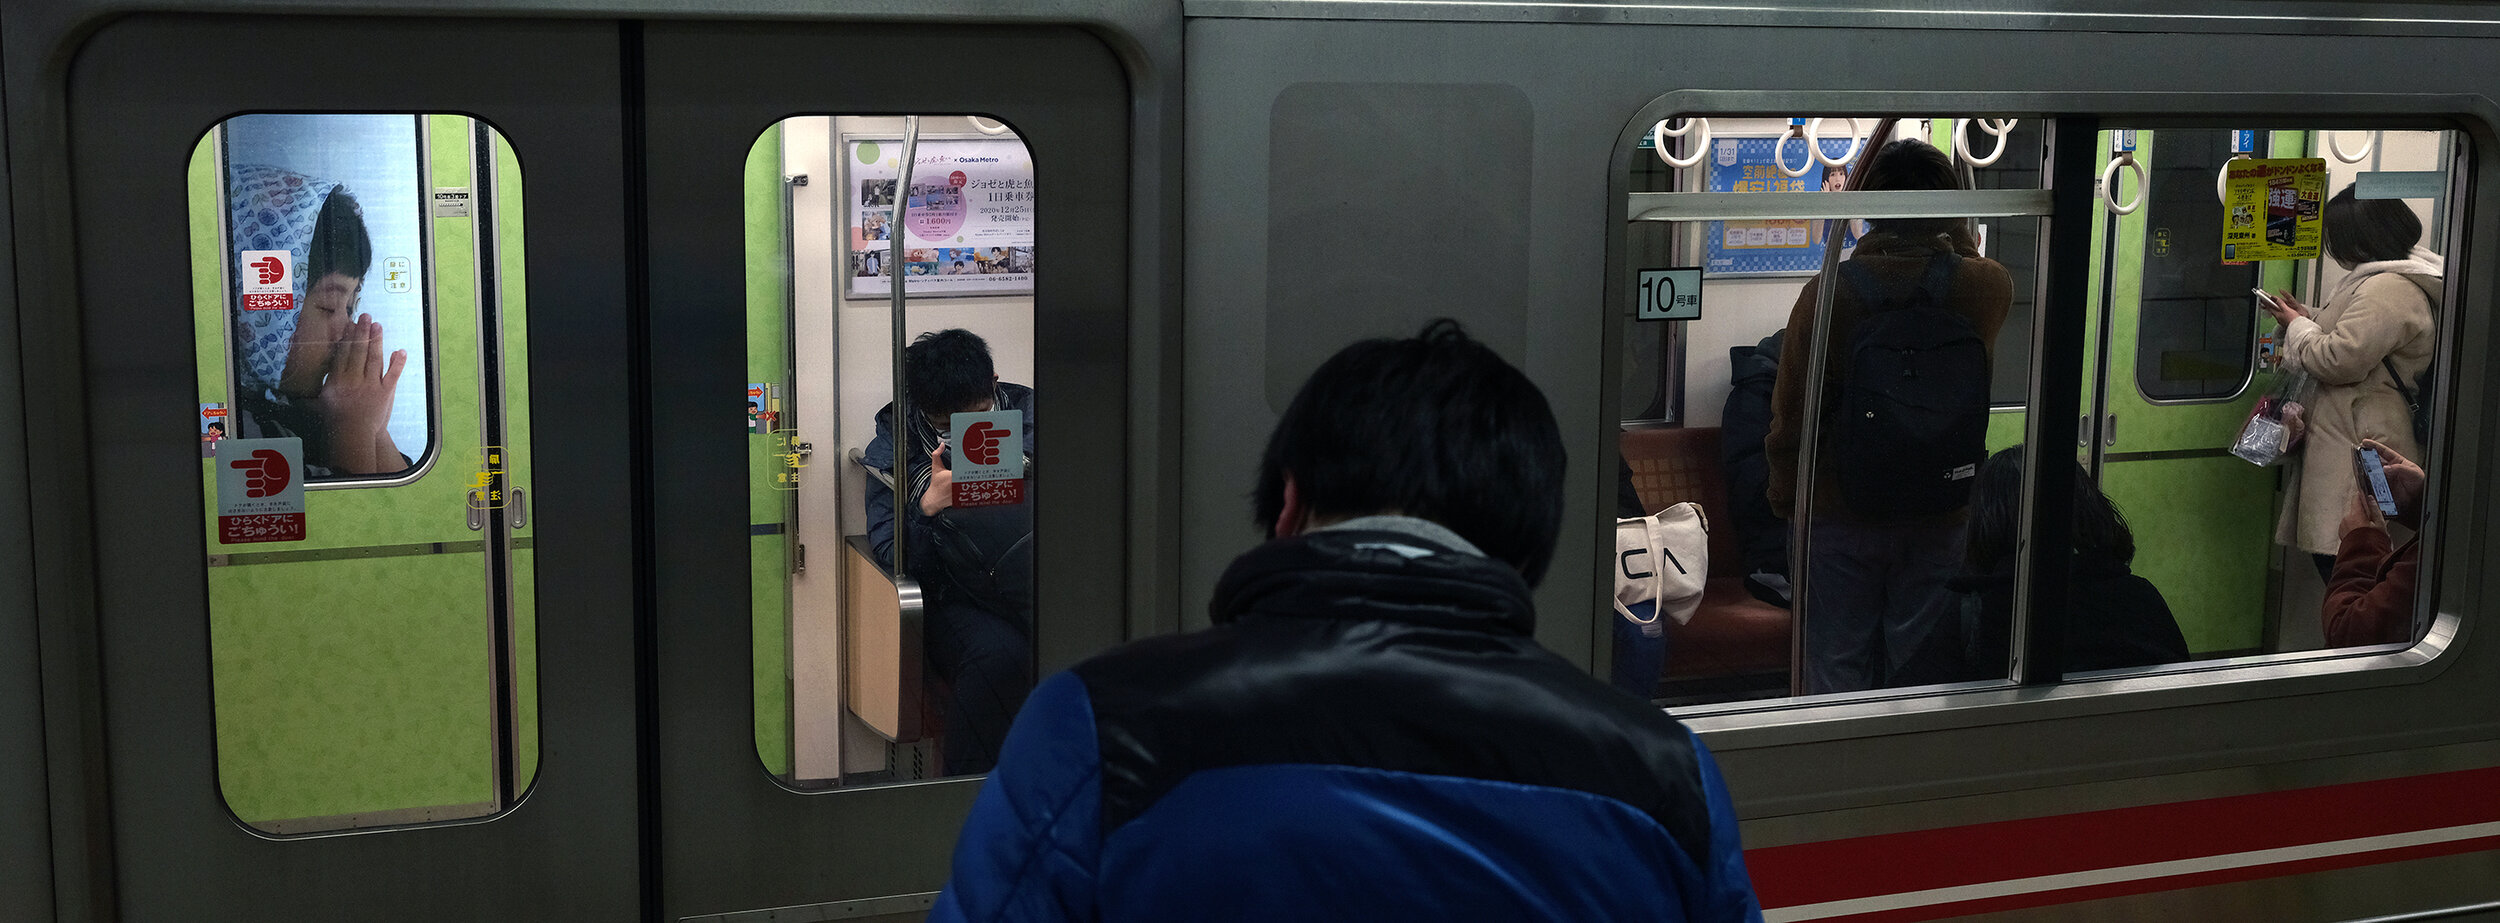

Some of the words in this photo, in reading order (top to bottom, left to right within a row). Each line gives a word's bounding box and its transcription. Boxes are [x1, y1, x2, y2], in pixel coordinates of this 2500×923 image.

[2268, 187, 2298, 209] 強運
[1642, 276, 1697, 312] 10号車
[248, 299, 290, 307] ごちゅうい!
[961, 480, 1014, 491] ひらくドアに
[958, 489, 1017, 502] ごちゅうい!
[230, 514, 294, 526] ひらくドアに
[227, 524, 299, 537] ごちゅうい!
